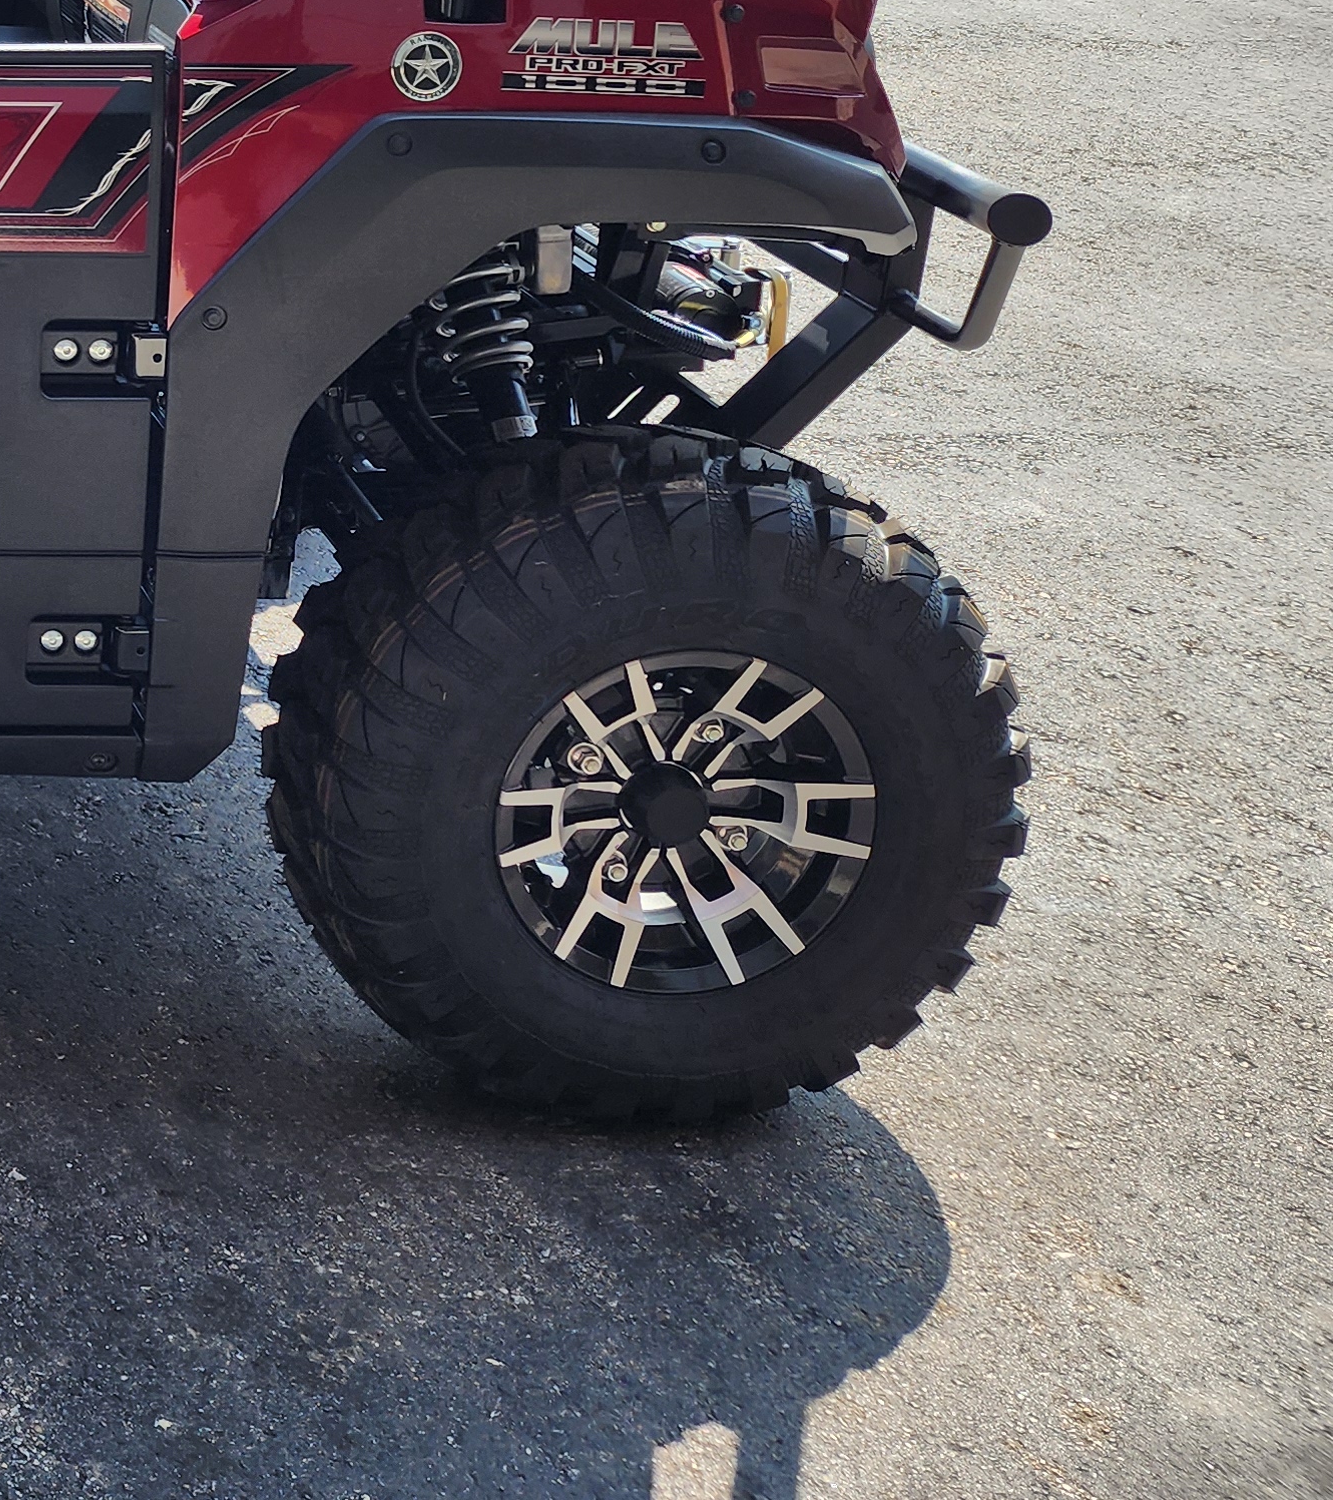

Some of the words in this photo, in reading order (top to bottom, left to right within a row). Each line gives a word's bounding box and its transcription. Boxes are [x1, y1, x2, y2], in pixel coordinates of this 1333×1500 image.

[508, 16, 705, 61] MULE
[525, 55, 687, 77] PRO-FXT
[520, 74, 687, 94] 1000
